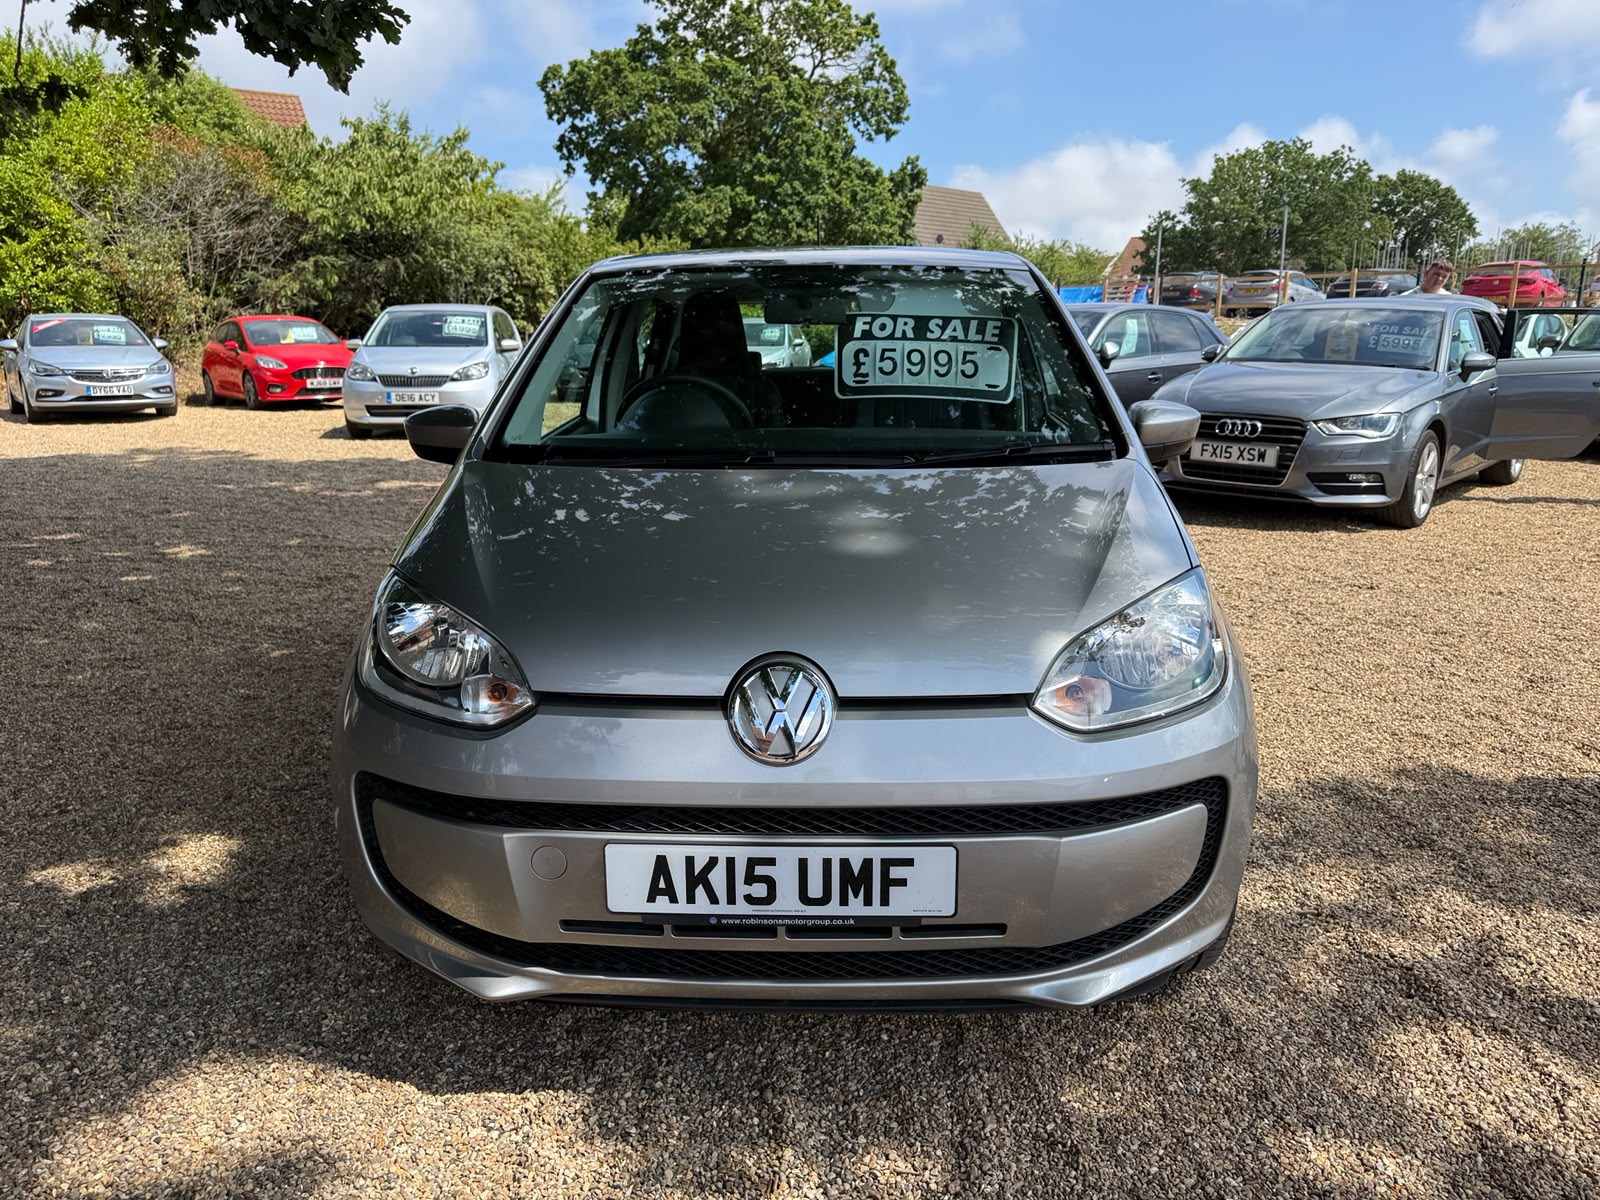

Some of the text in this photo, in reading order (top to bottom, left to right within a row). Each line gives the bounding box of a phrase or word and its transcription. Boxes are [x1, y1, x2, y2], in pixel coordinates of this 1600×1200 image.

[853, 316, 1002, 342] FOR SALE
[1371, 323, 1399, 333] FOR
[1368, 335, 1422, 351] £5995
[852, 347, 979, 380] £5995
[92, 385, 114, 395] DY66
[418, 393, 436, 402] ACY
[1201, 443, 1267, 463] FX15 XSW
[646, 854, 915, 907] AK15 UMF
[720, 917, 855, 927] www.robinsonsmotorgroup.co.uk
